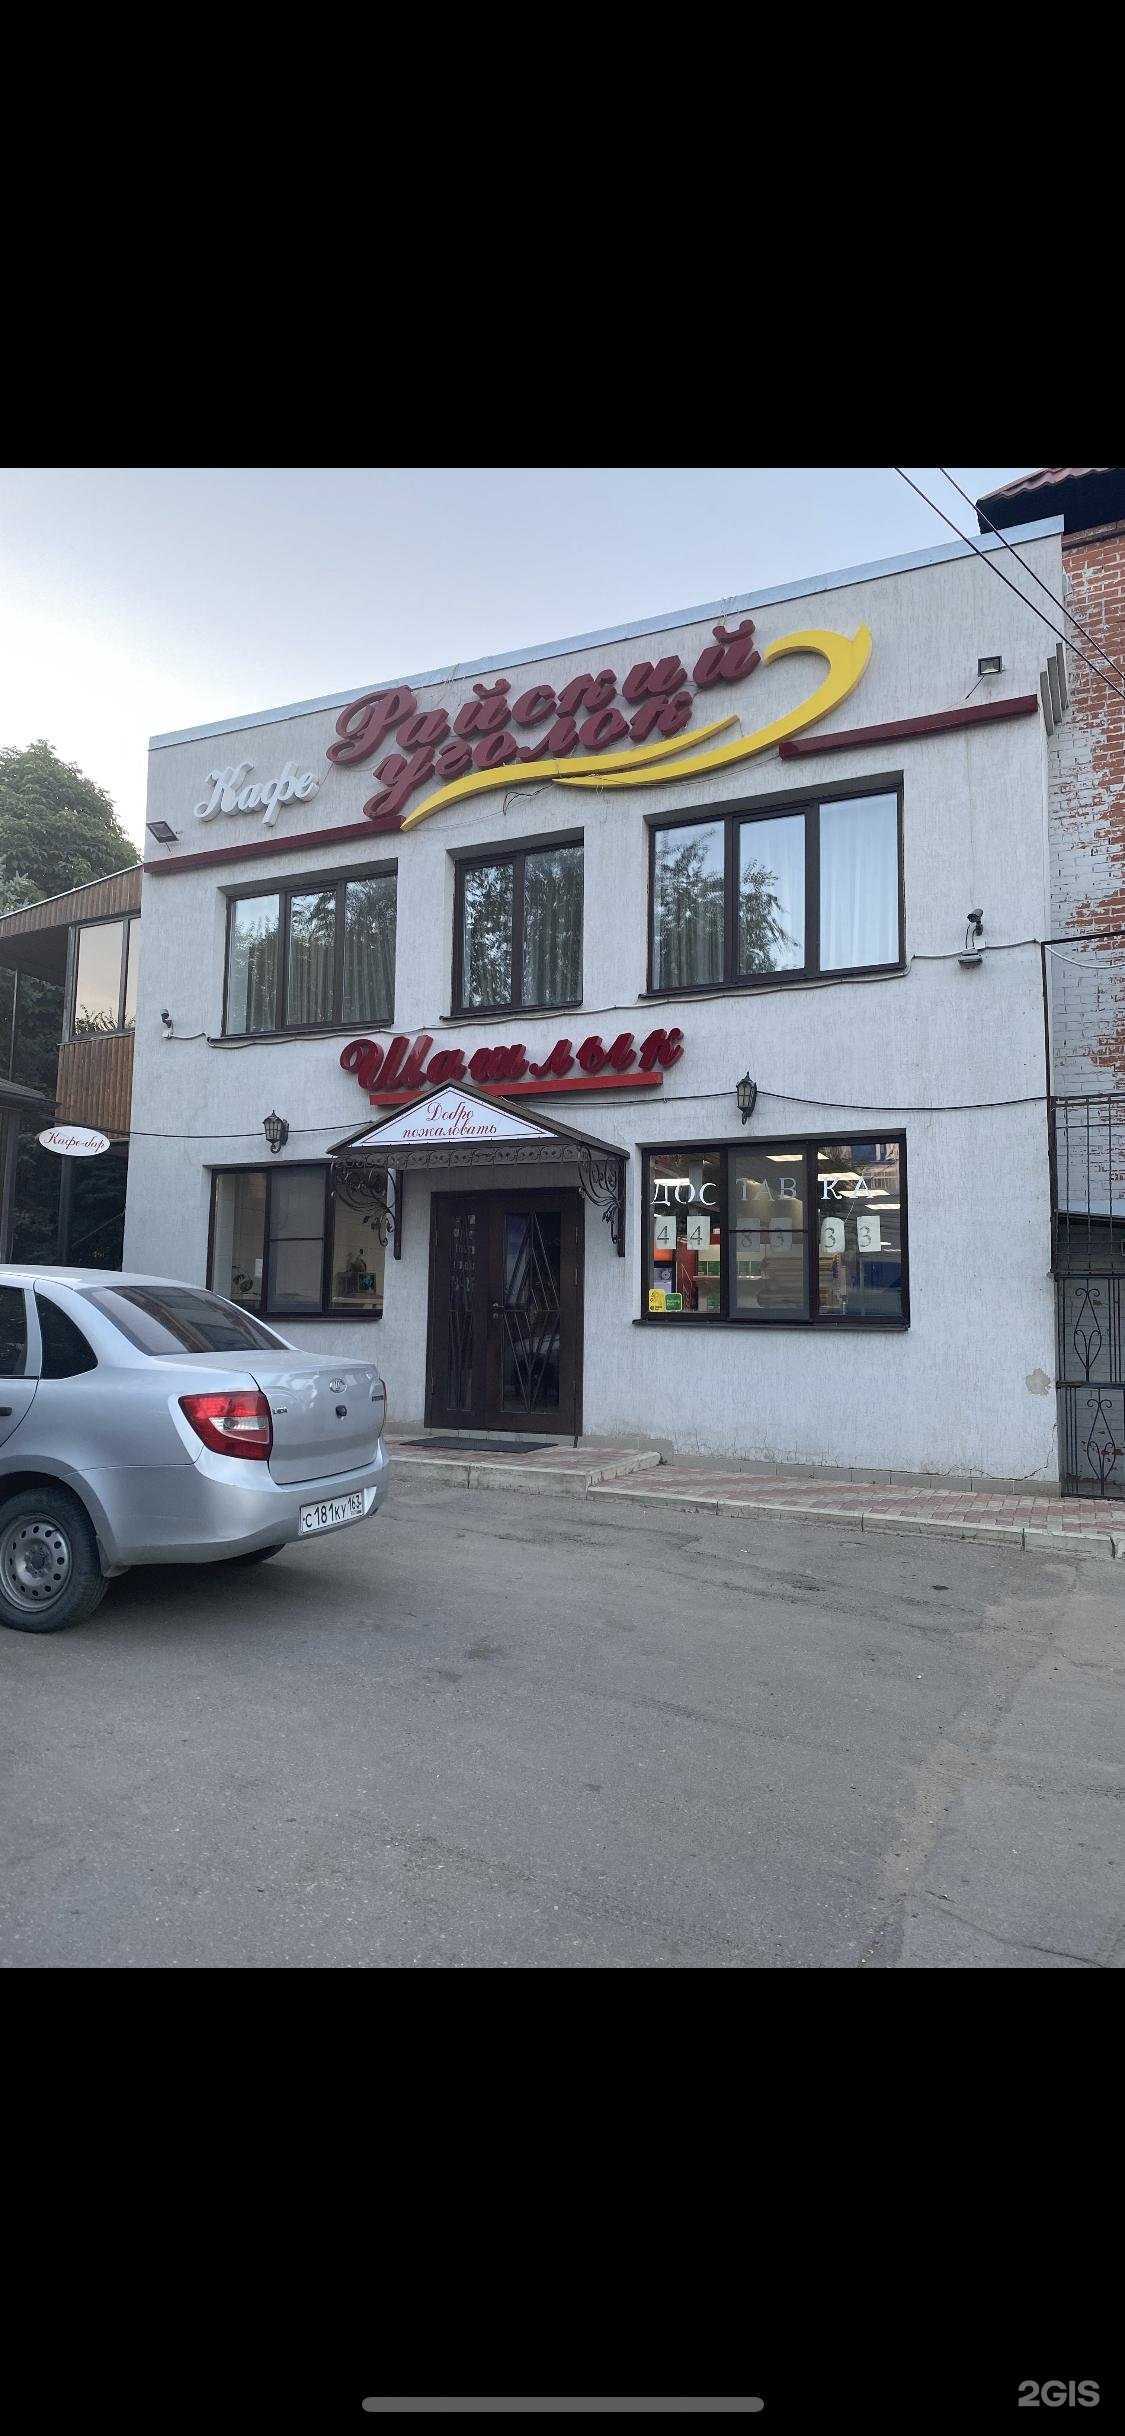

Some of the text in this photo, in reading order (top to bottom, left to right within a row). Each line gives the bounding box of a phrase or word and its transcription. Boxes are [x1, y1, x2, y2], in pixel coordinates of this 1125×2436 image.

[326, 619, 761, 766] Райский
[194, 760, 320, 827] Кафе
[340, 1028, 684, 1091] Шашлык
[402, 1119, 498, 1139] пожаловать
[426, 1102, 474, 1129] Добро
[44, 1132, 105, 1153] Кафе-бар
